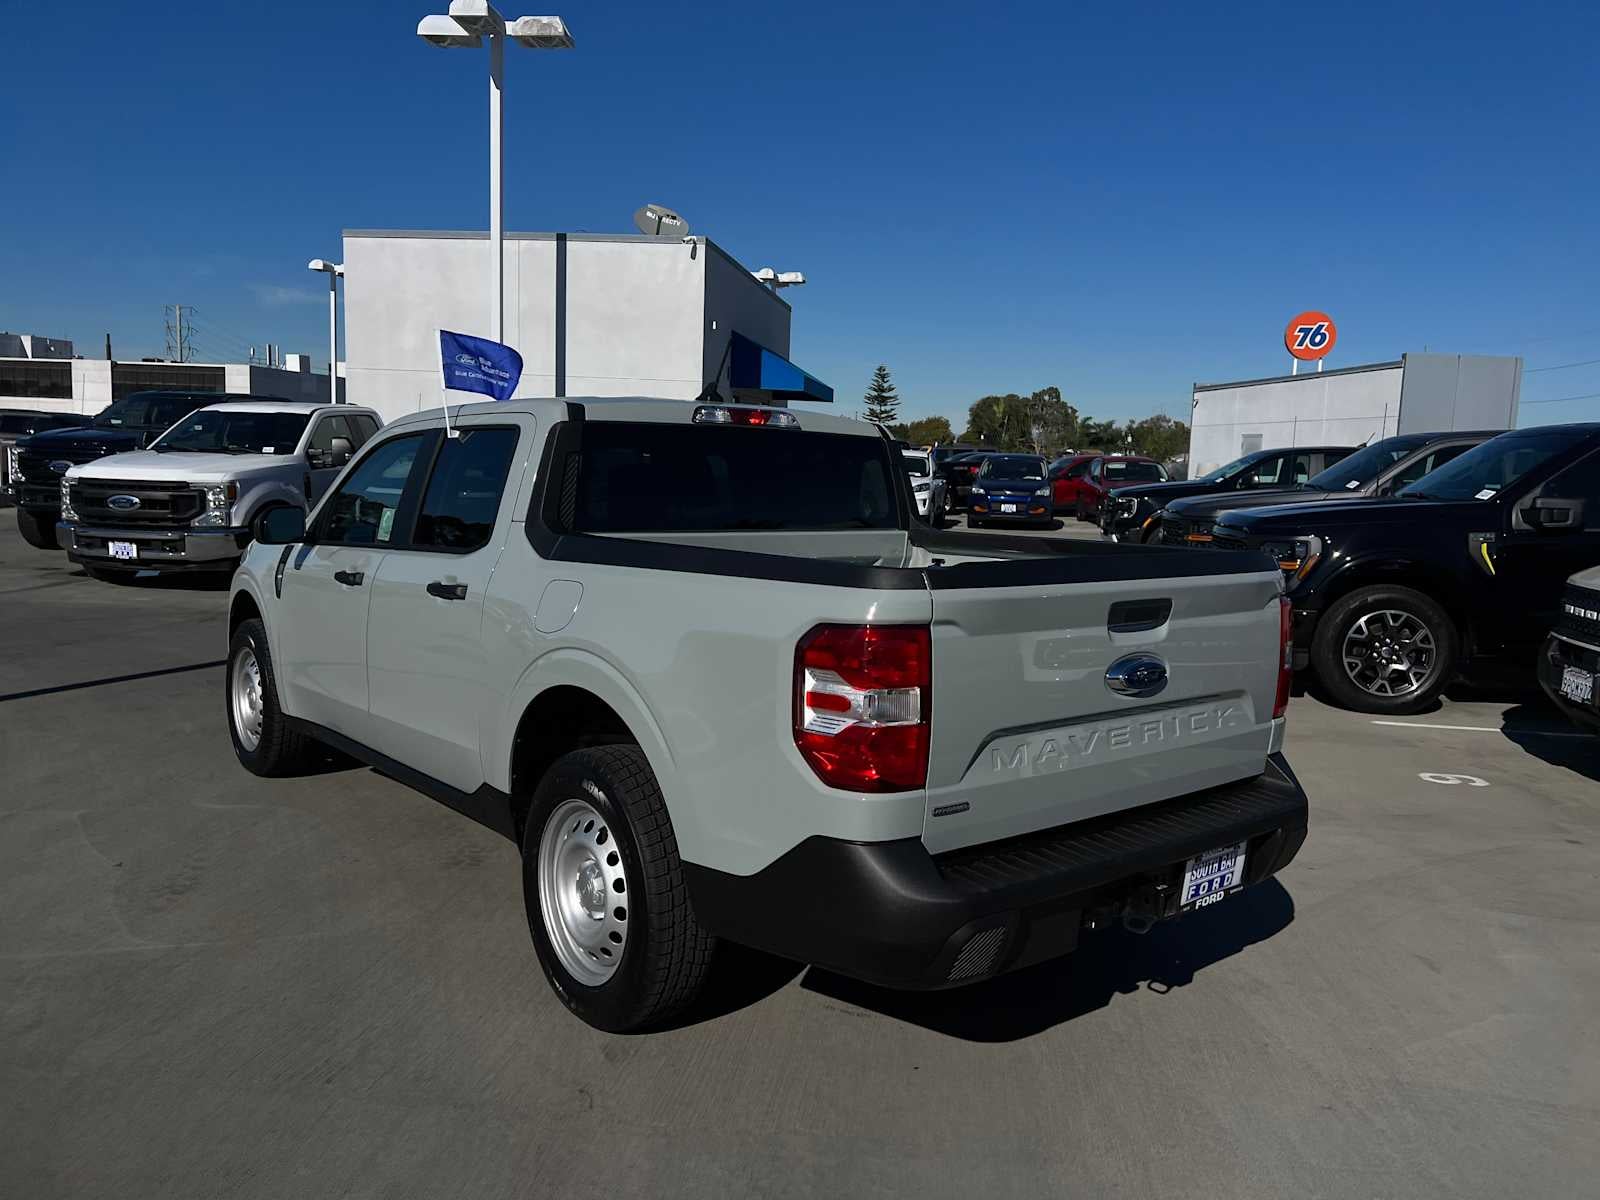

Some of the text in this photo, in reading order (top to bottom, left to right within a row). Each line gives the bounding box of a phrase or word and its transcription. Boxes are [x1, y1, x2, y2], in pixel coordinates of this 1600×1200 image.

[1293, 321, 1330, 350] 76
[990, 705, 1236, 773] MAVERICK
[1187, 873, 1233, 900] FORD
[1195, 891, 1225, 910] FORD
